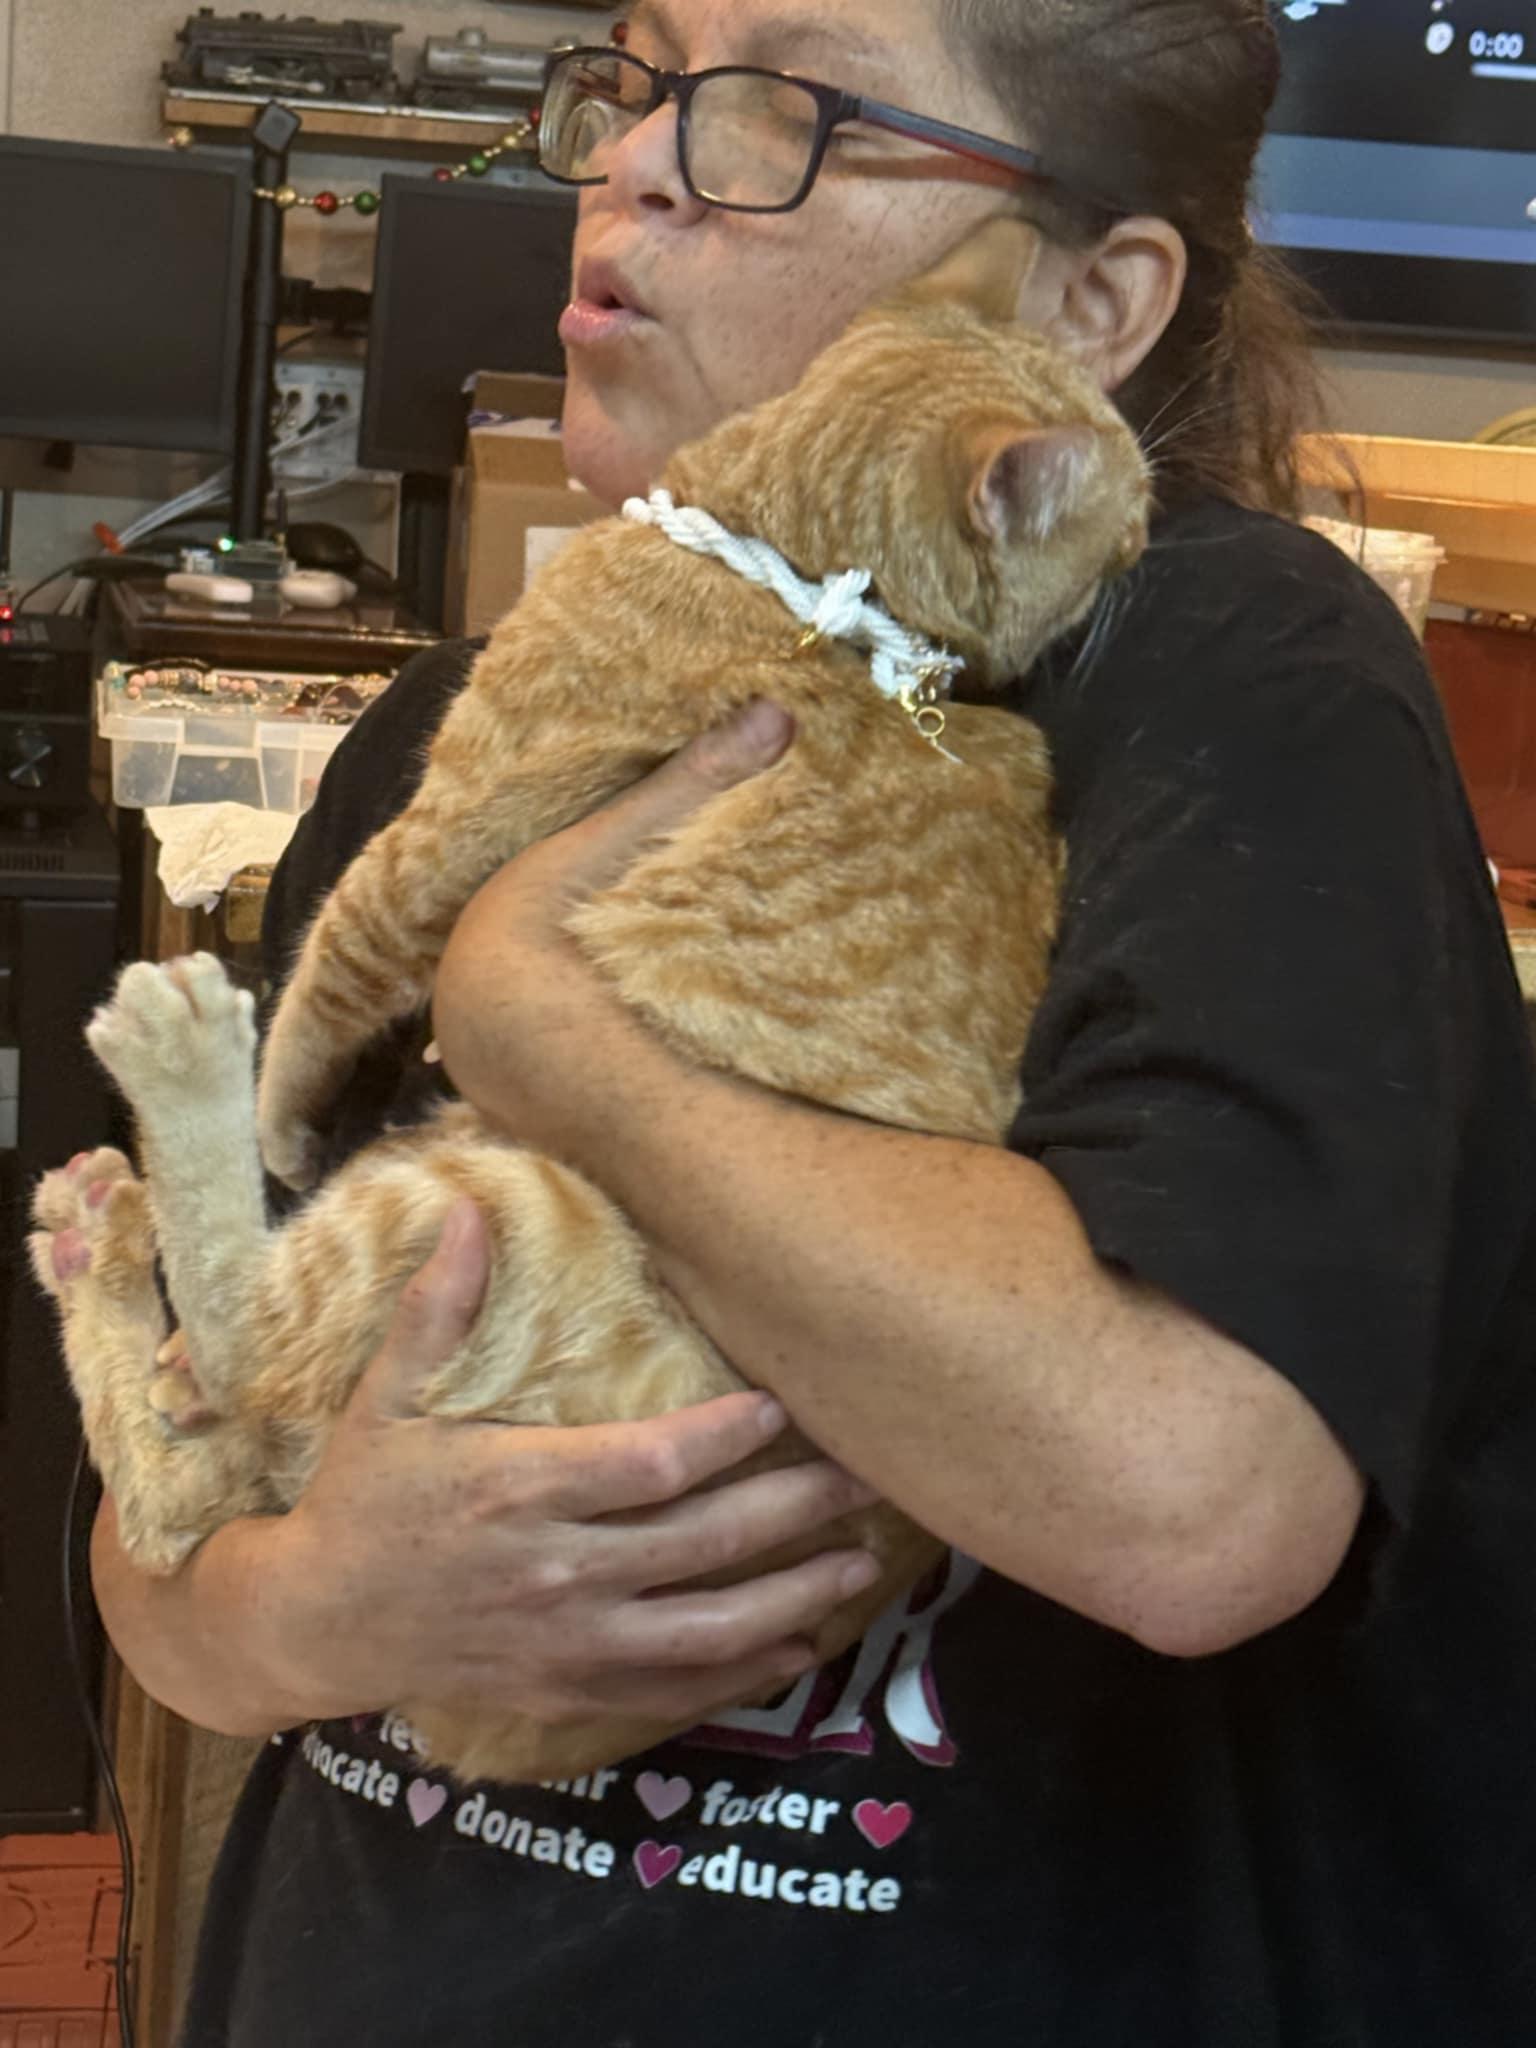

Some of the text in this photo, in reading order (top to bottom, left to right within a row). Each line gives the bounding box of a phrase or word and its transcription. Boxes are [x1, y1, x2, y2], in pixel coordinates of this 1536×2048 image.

[1469, 30, 1525, 59] 0:00
[700, 1780, 841, 1834] foster
[454, 1791, 616, 1878] donate
[677, 1845, 901, 1912] educate
